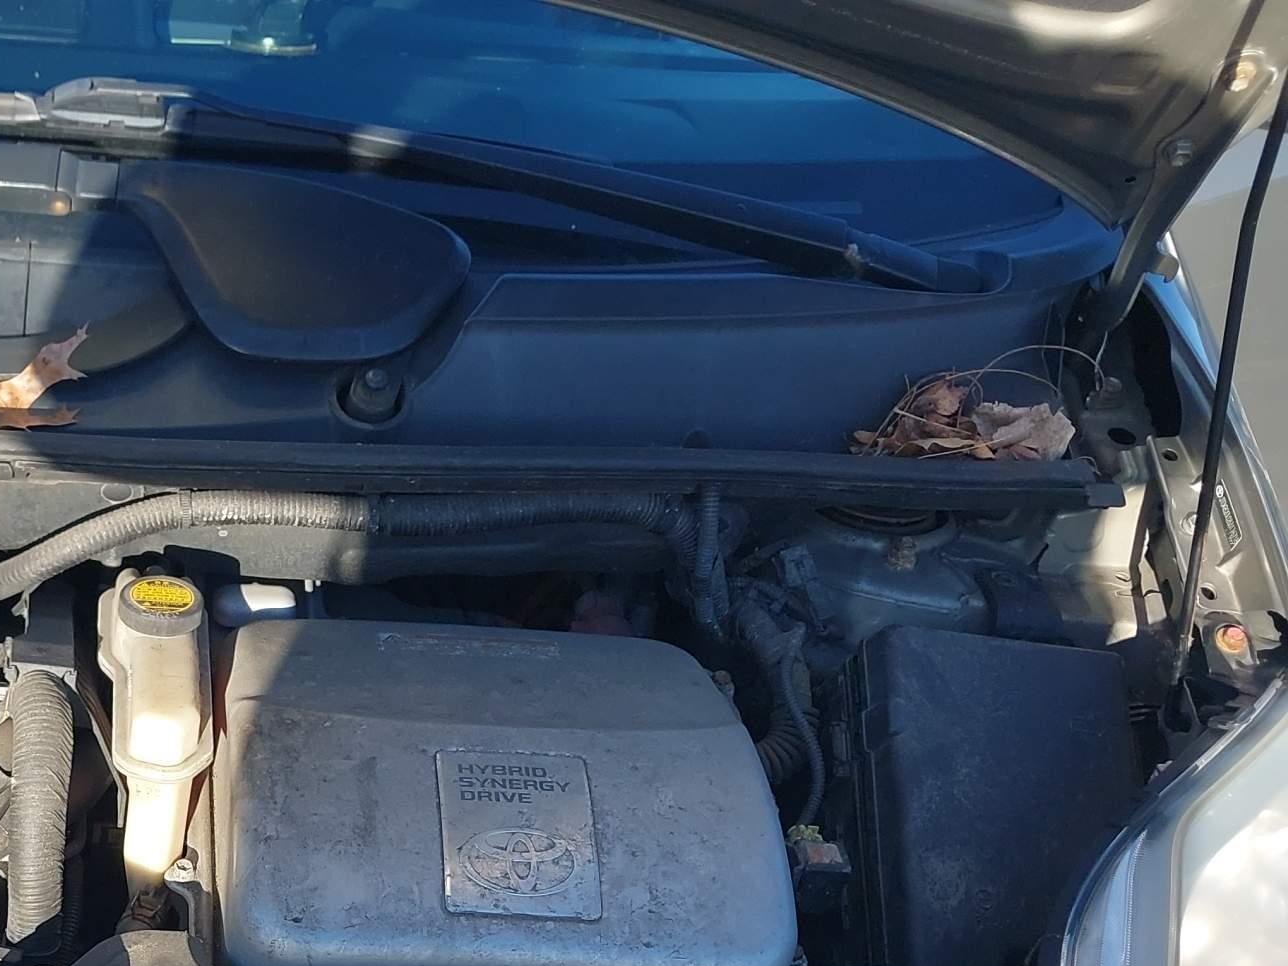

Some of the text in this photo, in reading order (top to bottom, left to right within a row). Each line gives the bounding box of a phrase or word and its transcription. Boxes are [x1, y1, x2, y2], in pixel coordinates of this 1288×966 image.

[457, 763, 548, 778] HYBRID
[458, 776, 571, 793] SYNERGY
[460, 790, 534, 804] DRIVE
